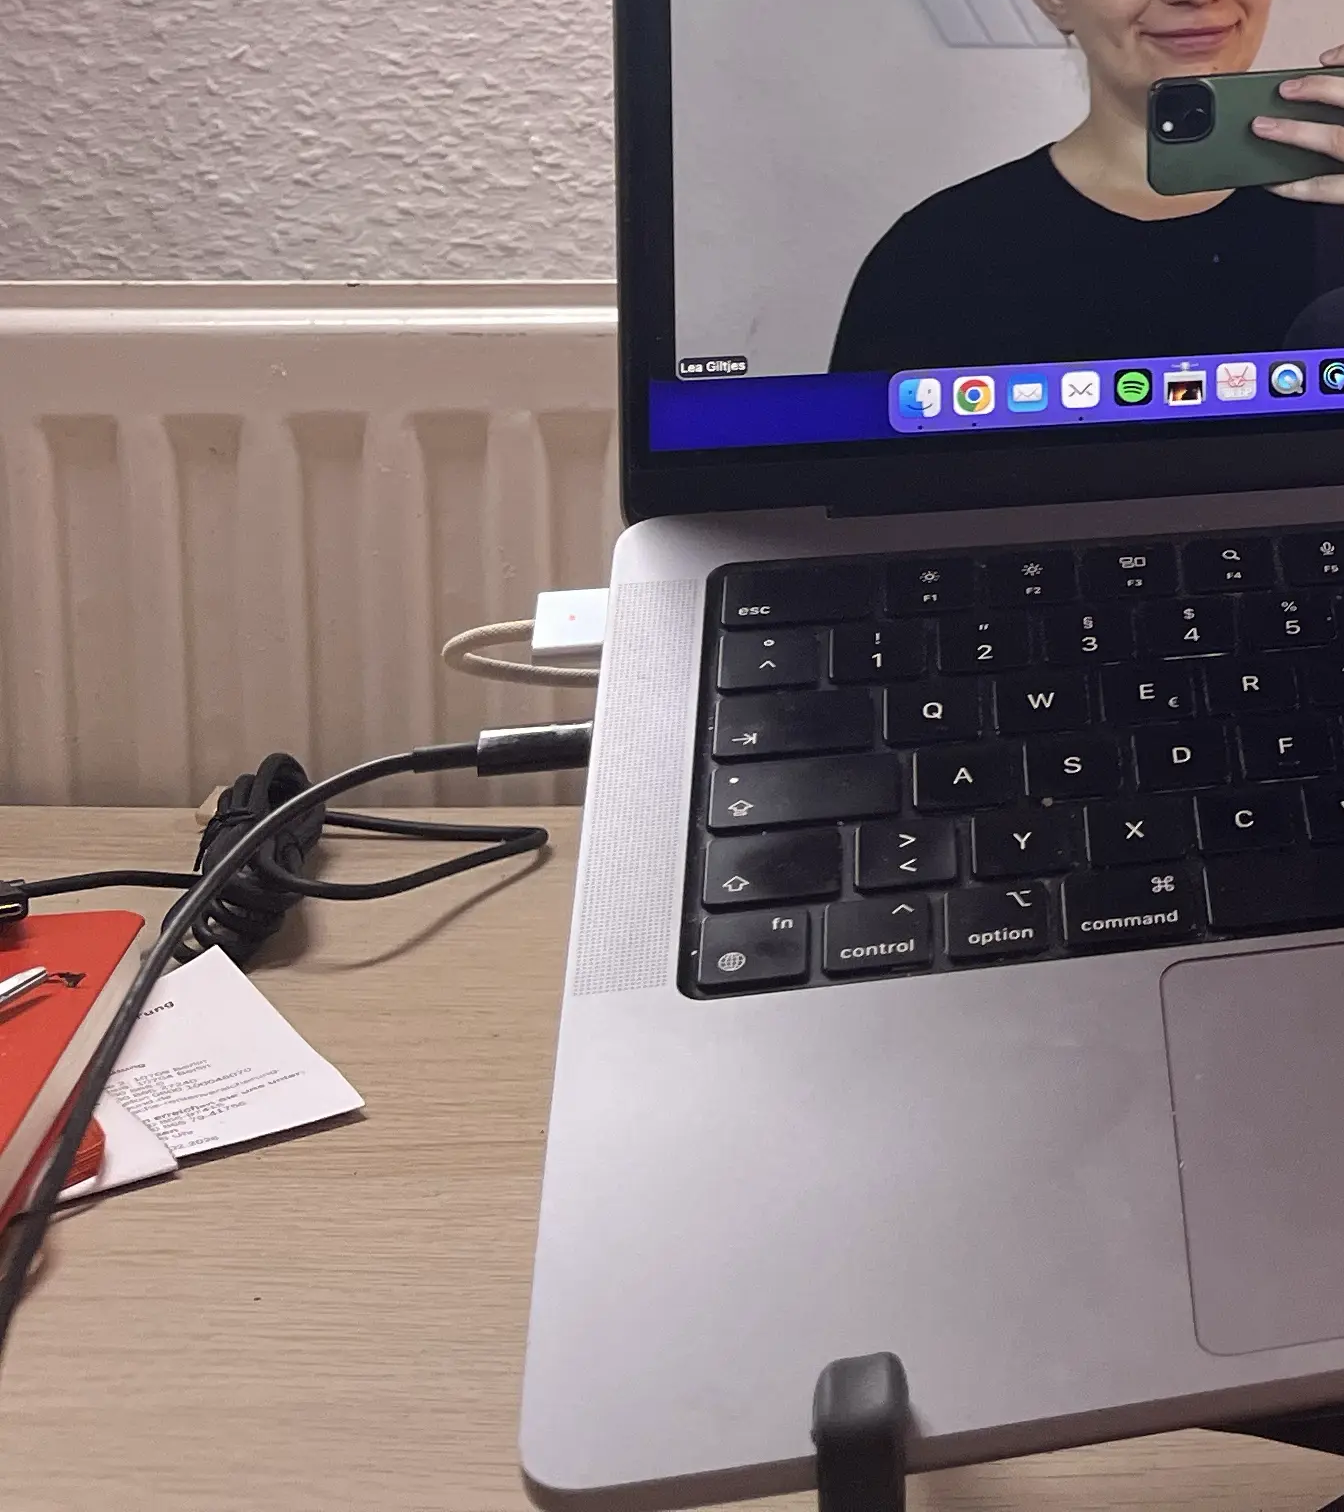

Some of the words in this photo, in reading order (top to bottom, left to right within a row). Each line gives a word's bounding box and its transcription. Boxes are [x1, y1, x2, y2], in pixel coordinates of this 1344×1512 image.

[680, 361, 703, 374] Lea
[923, 594, 937, 602] F1
[1025, 586, 1042, 595] F2
[1126, 579, 1143, 587] F3
[1226, 571, 1242, 580] F4
[1323, 564, 1339, 573] F5
[738, 606, 771, 616] esc
[1183, 608, 1195, 620] $
[1281, 601, 1298, 612] %
[871, 652, 882, 668] 1
[977, 644, 993, 660] 2
[1081, 636, 1098, 652] 3
[1183, 627, 1201, 642] 4
[1285, 619, 1301, 635] 5
[922, 702, 943, 719] Q
[1027, 692, 1055, 710] W
[1139, 683, 1156, 700] E
[1242, 675, 1260, 692] R
[953, 767, 973, 785] A
[1063, 756, 1082, 774] S
[1172, 746, 1191, 764] D
[1278, 737, 1293, 754] F
[1013, 831, 1032, 850] Y
[1125, 820, 1145, 839] X
[1235, 810, 1254, 828] C
[772, 917, 793, 930] fn
[840, 939, 914, 959] control
[968, 927, 1033, 946] option
[1081, 909, 1178, 932] command
